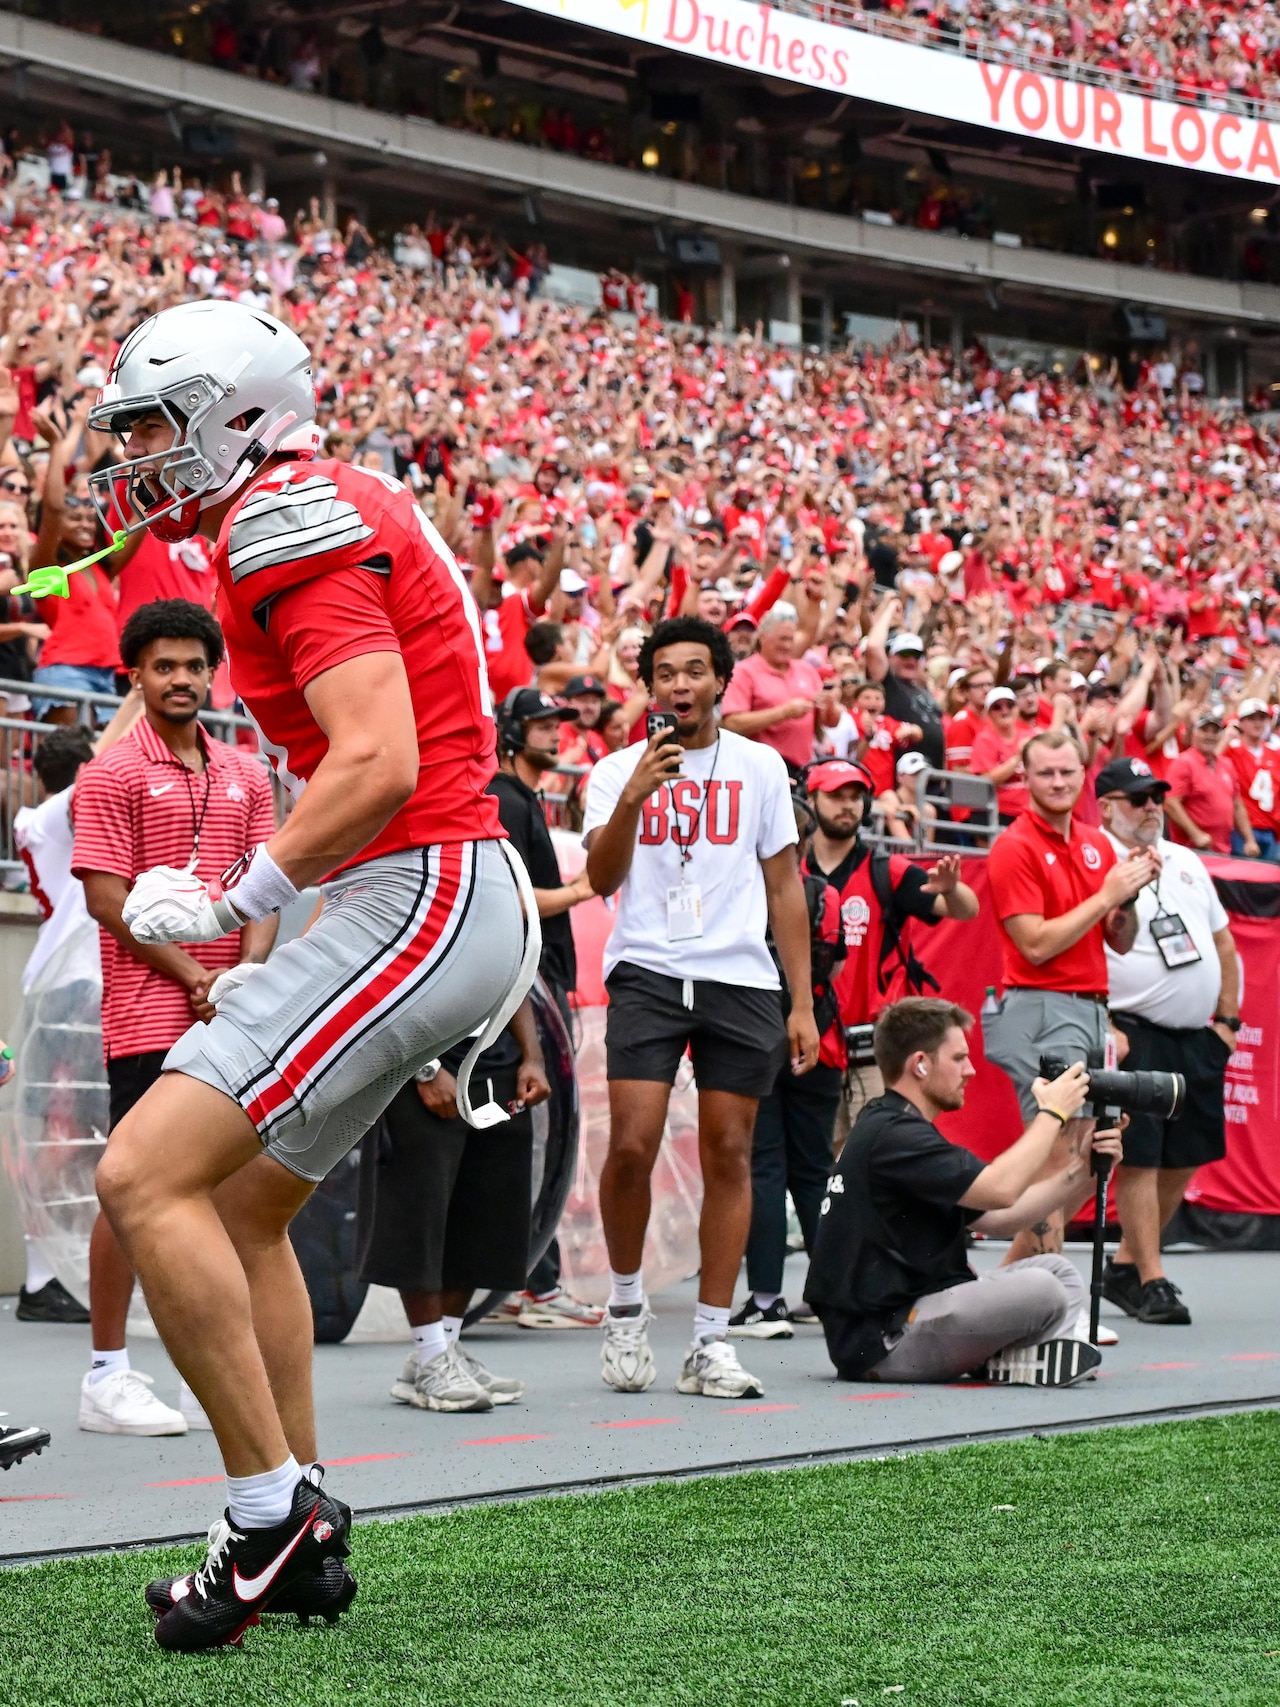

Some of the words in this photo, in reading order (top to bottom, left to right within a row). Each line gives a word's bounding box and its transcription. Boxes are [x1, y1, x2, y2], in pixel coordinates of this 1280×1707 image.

[663, 0, 850, 86] Duchess
[978, 61, 1123, 148] YOUR
[1143, 97, 1280, 178] LOCA
[639, 780, 743, 846] BSU
[1249, 767, 1274, 812] 4
